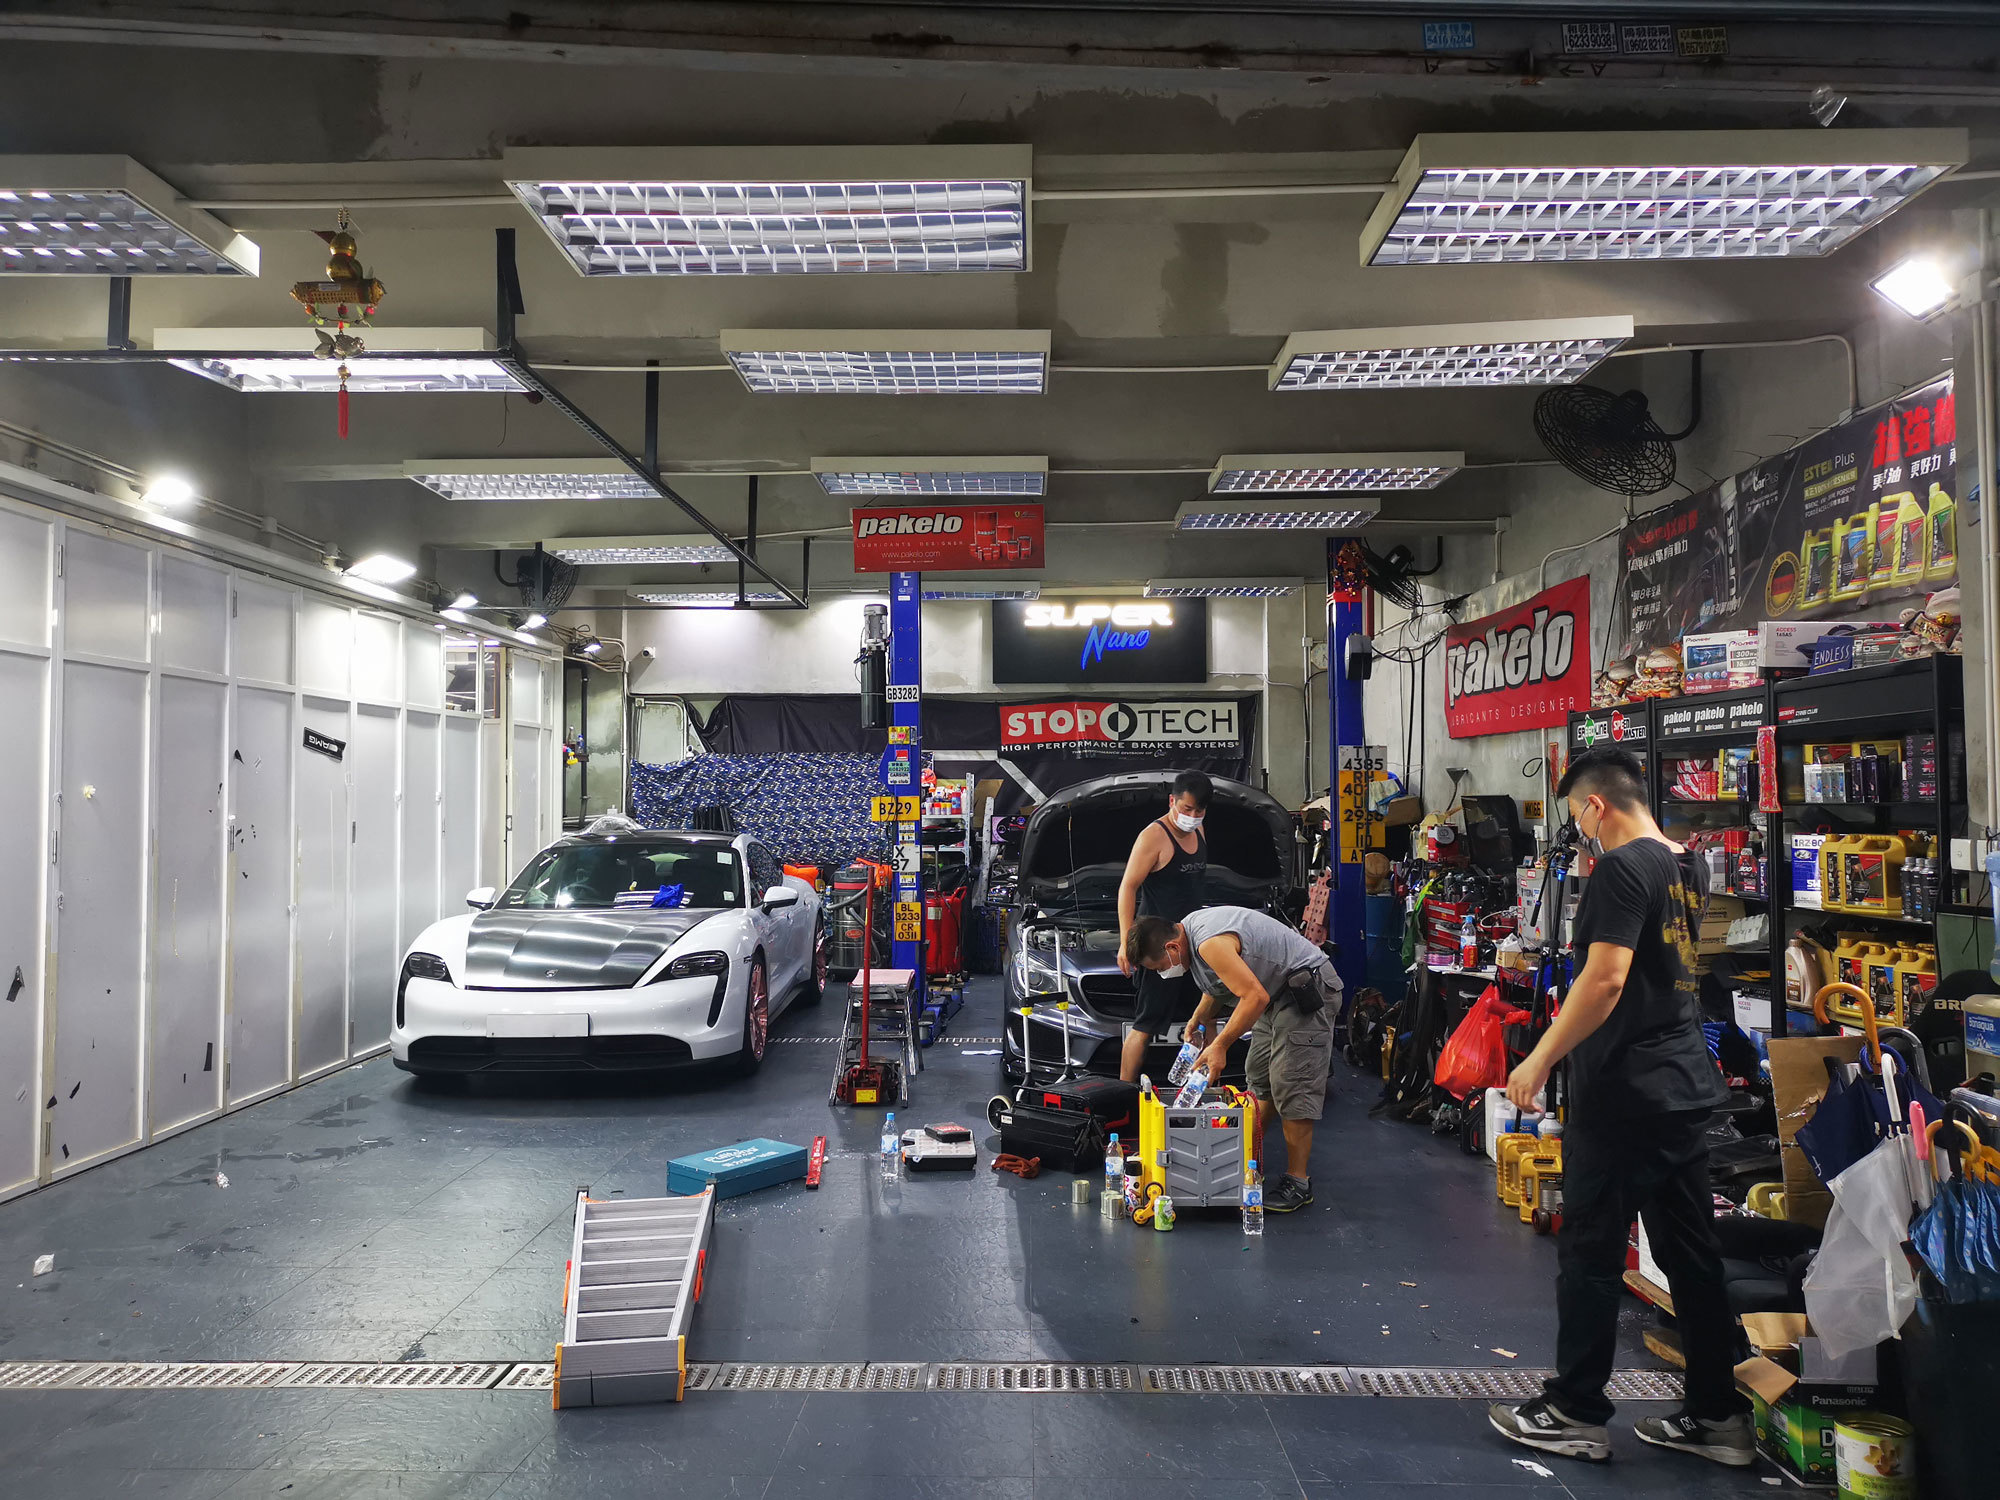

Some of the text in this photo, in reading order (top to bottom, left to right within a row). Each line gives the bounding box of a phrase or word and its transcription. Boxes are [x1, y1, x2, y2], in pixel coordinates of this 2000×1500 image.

[1569, 33, 1612, 48] 6233 9038
[1629, 38, 1649, 51] 9602
[1835, 452, 1855, 469] Plus
[1910, 454, 1942, 479] 更好力
[1872, 466, 1902, 491] 更油
[857, 512, 964, 539] pakelo
[881, 550, 941, 559] www.pakelo.com
[1023, 603, 1174, 627] SUPER
[1080, 622, 1151, 671] Nano
[1447, 606, 1575, 707] pakelo
[1814, 643, 1850, 667] ENDLESS
[887, 687, 918, 701] GB3282
[1511, 697, 1575, 718] DESIGNER
[1663, 701, 1763, 727] pakelo pakelo pakelo
[1624, 726, 1647, 738] MASTER
[308, 735, 330, 749] AMG
[1001, 744, 1031, 752] HIGH
[1037, 741, 1125, 750] PERFORMANCE
[1131, 741, 1173, 749] BRAKE
[1353, 746, 1373, 759] TT
[1343, 758, 1383, 771] 4385
[879, 802, 913, 816] BZ29
[895, 846, 905, 858] X
[891, 858, 910, 871] 87
[900, 903, 914, 912] BL
[895, 912, 921, 921] 3233
[900, 923, 914, 932] CR
[898, 931, 918, 940] 0311
[1811, 1395, 1867, 1407] Panasonic
